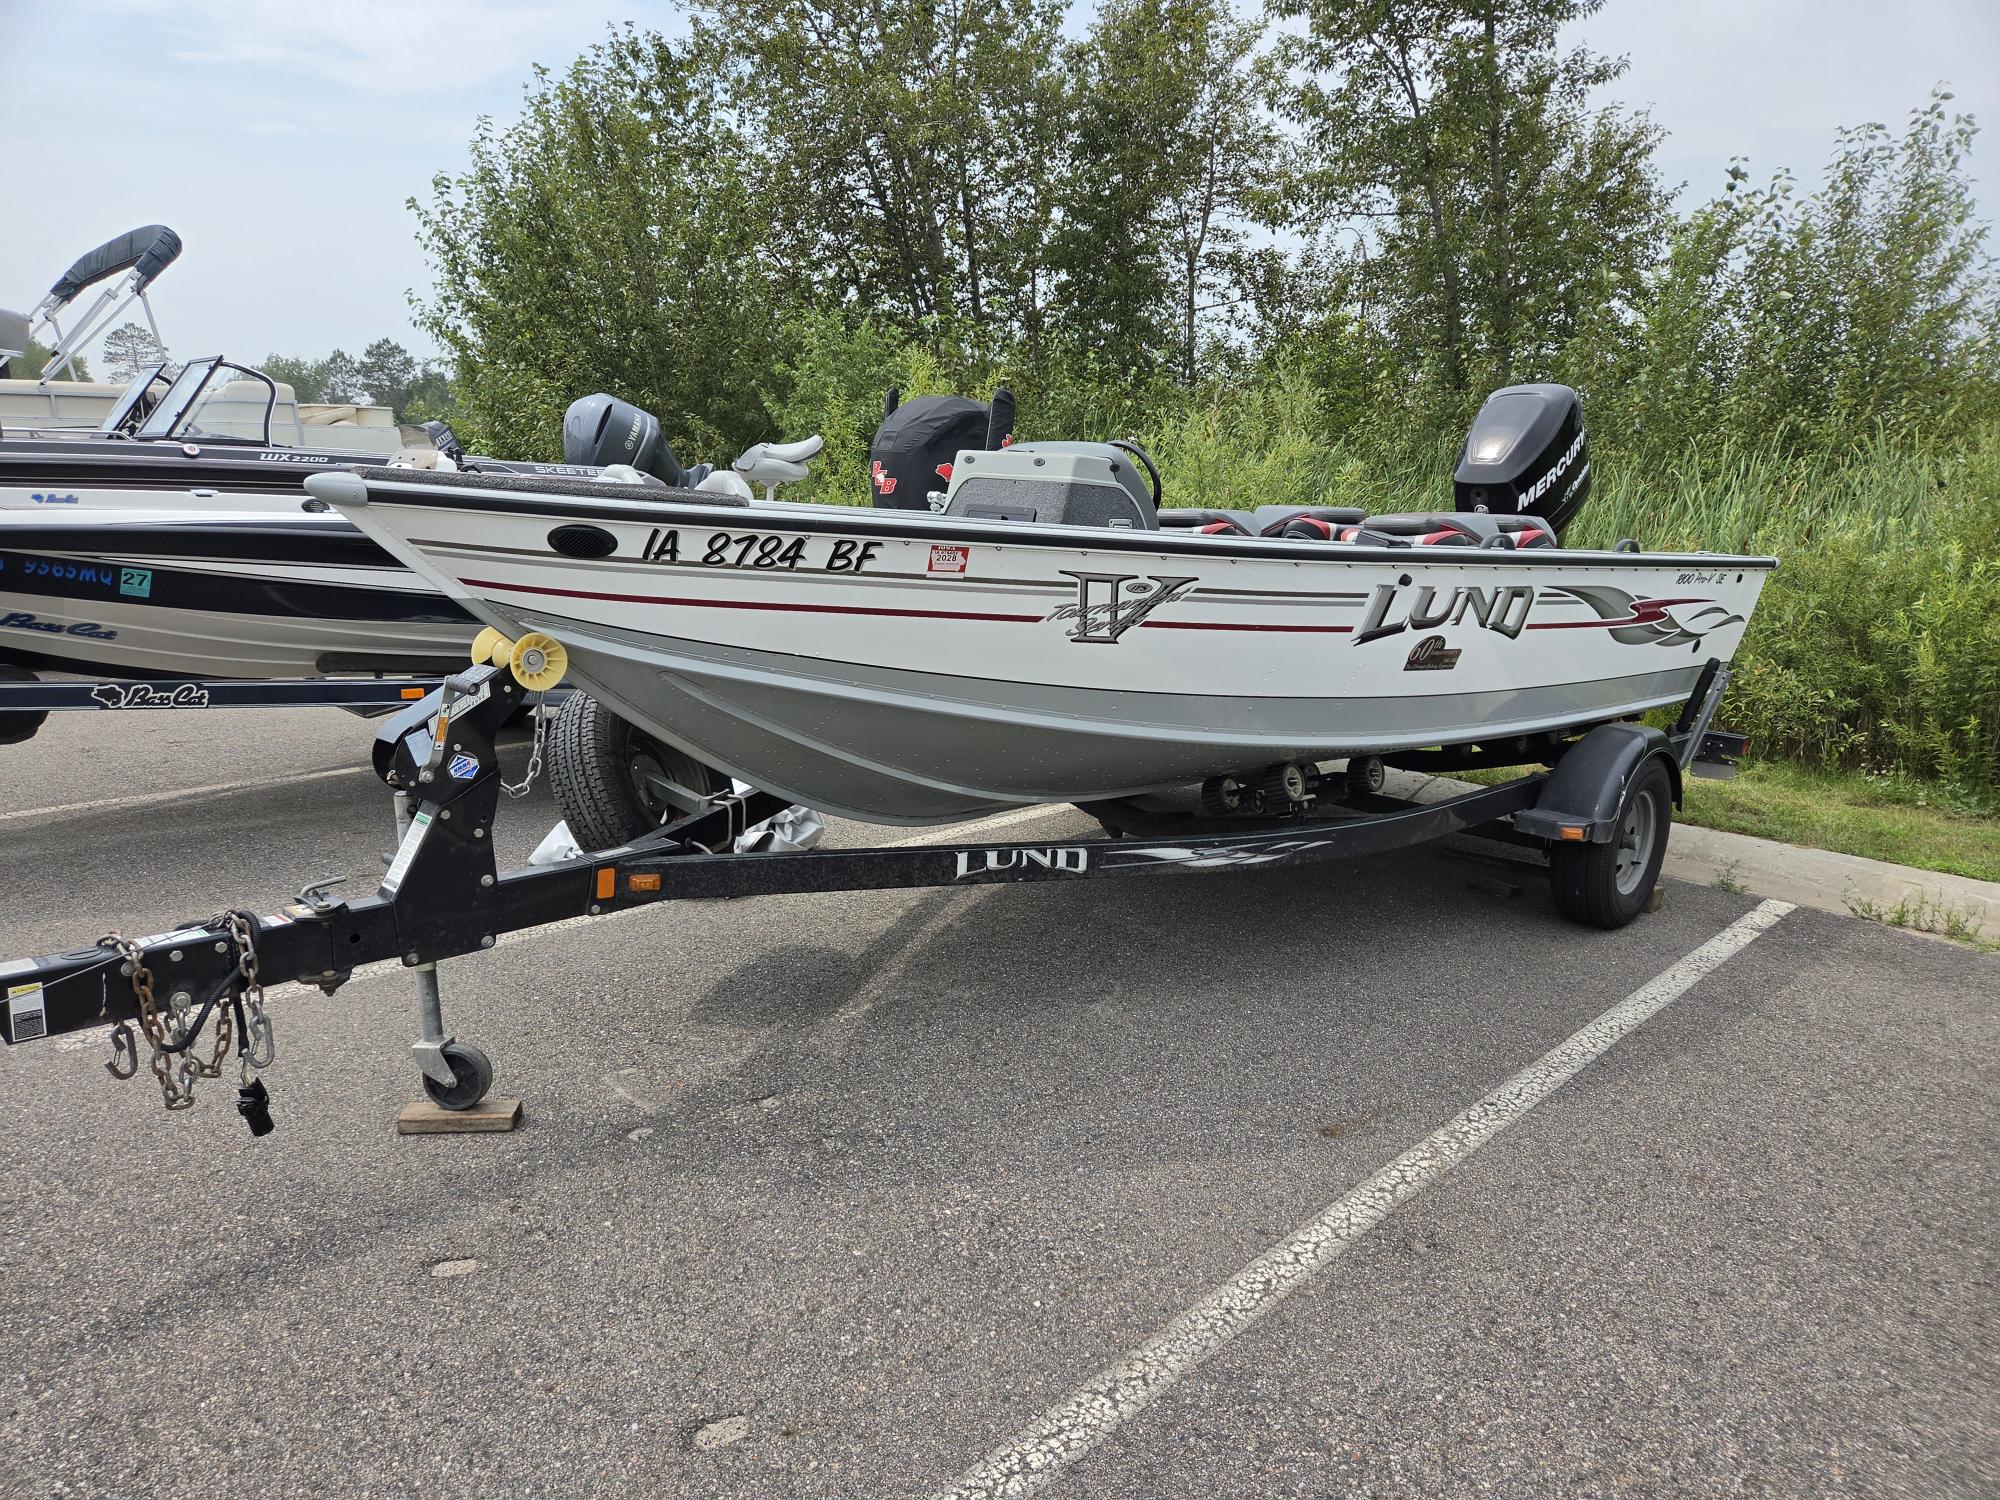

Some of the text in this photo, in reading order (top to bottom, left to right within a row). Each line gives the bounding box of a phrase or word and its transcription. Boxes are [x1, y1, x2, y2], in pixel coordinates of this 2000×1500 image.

[1516, 430, 1586, 512] MERCURY
[641, 527, 886, 575] IA 8784 BF
[122, 572, 149, 587] 27
[66, 622, 119, 640] Cat
[1352, 583, 1535, 647] LUND
[121, 684, 209, 709] Bass Cat
[954, 848, 1088, 880] LUND
